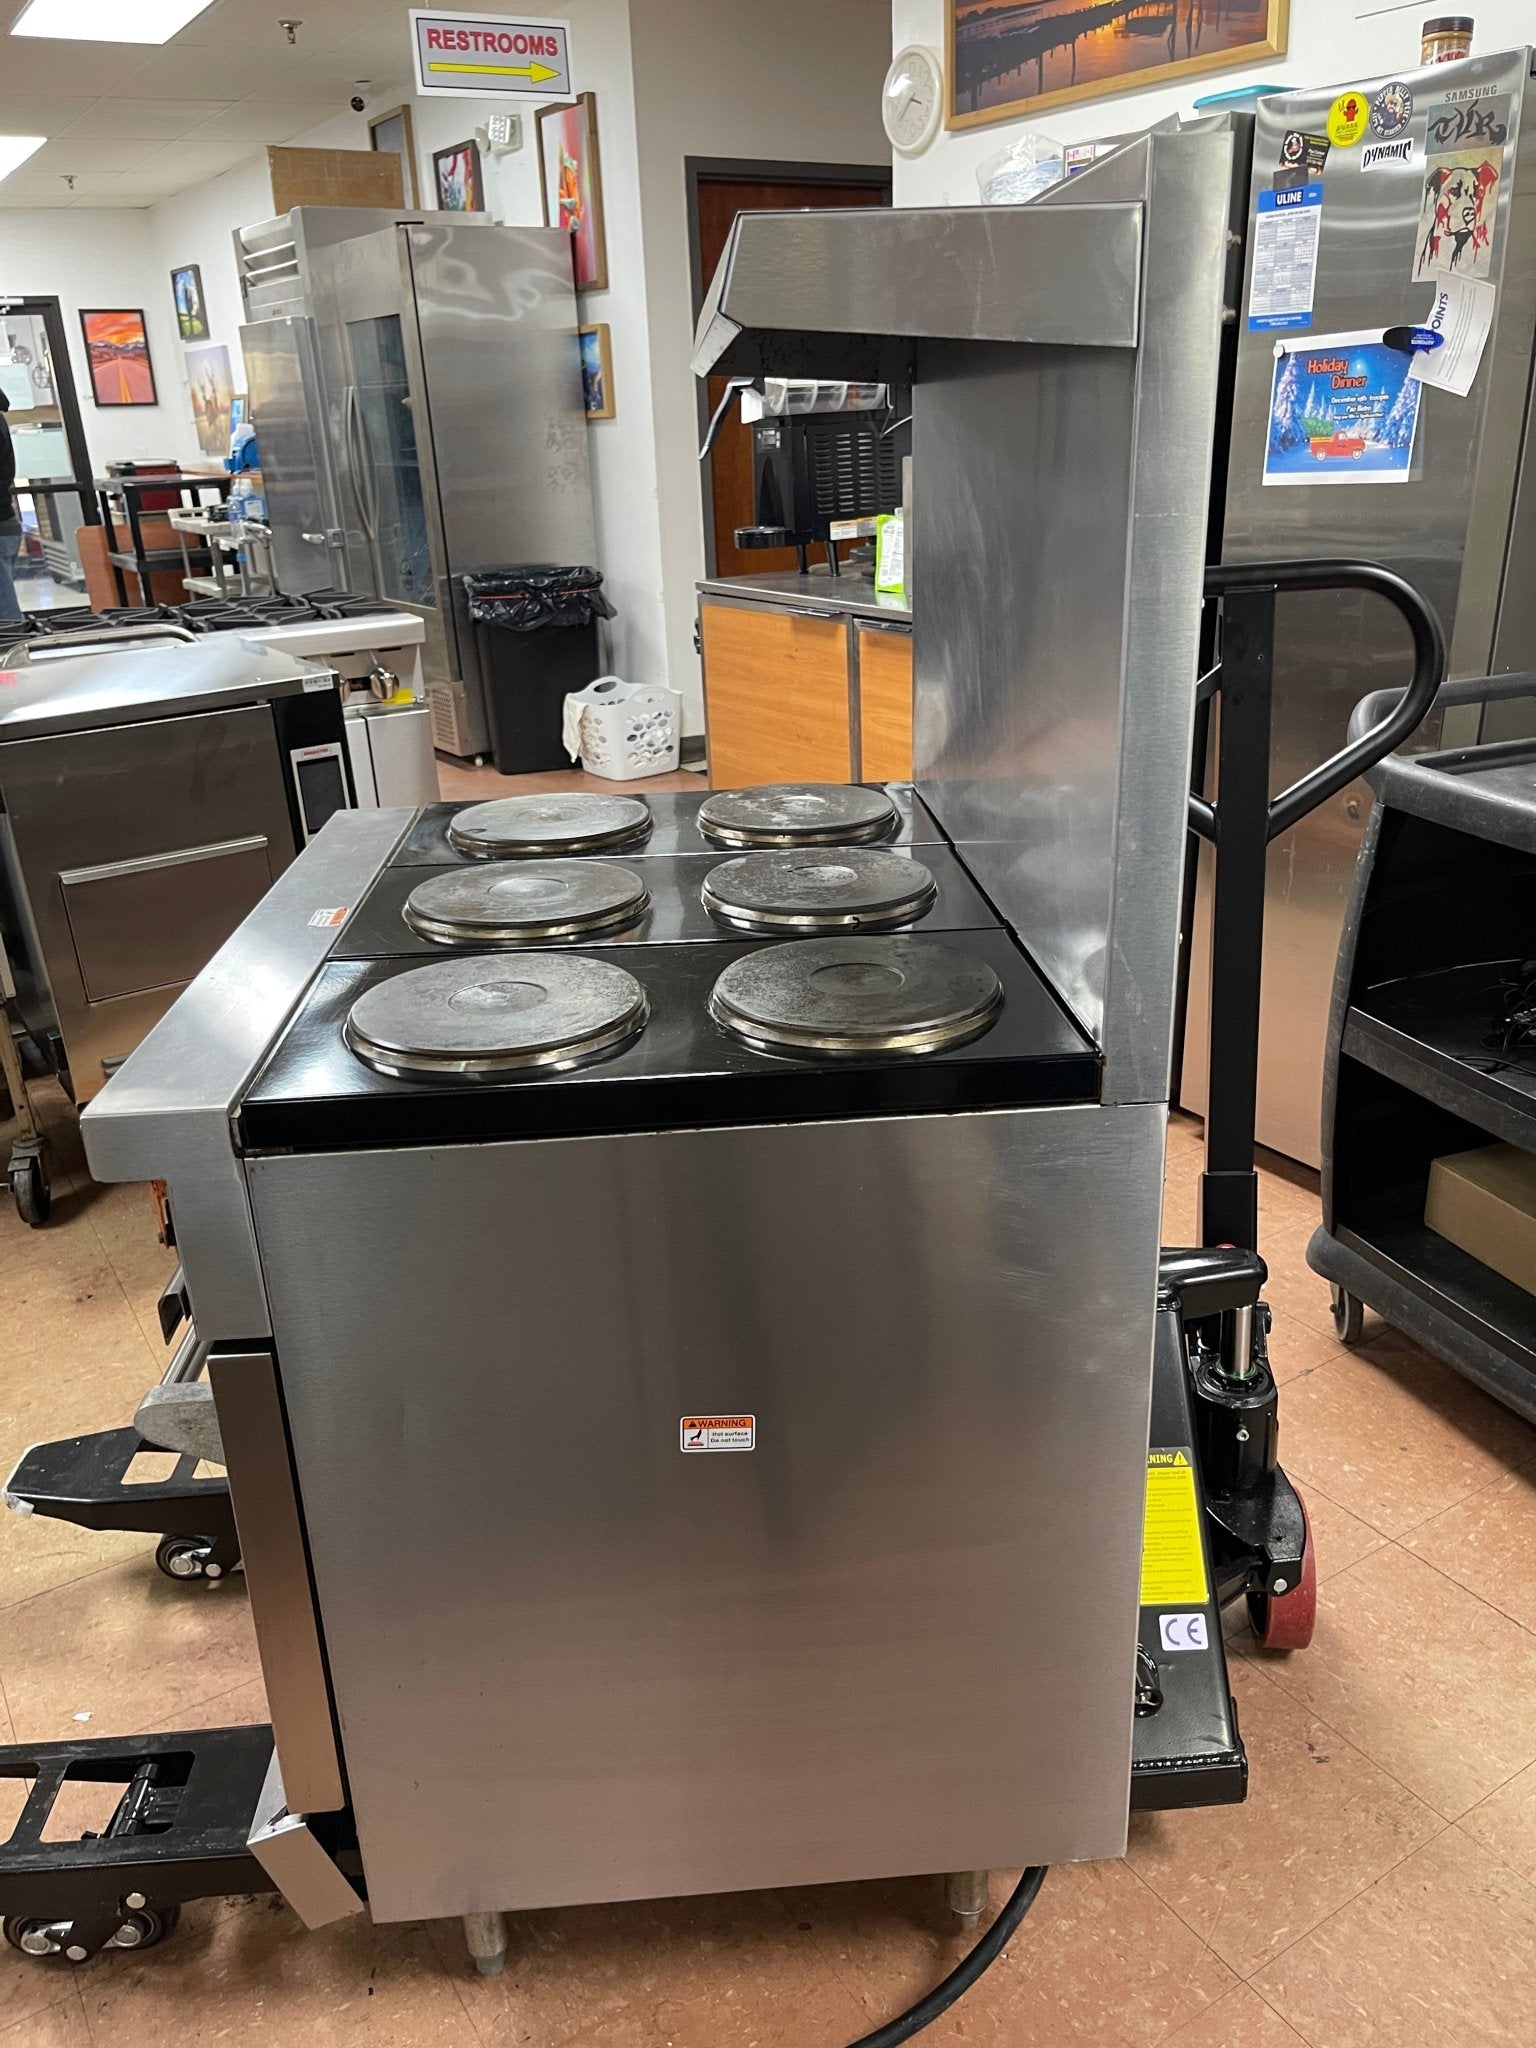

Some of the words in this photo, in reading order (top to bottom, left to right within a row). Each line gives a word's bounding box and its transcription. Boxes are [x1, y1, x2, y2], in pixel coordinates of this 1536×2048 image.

[426, 28, 559, 57] RESTROOMS
[1445, 85, 1497, 102] SAMSUNG
[1363, 140, 1412, 169] DYNAMIC
[1276, 191, 1303, 205] ULINE
[1307, 357, 1349, 375] Holiday
[1331, 375, 1367, 390] Dinner
[698, 1419, 746, 1427] WARNING
[1148, 1453, 1173, 1464] NING
[1165, 1617, 1202, 1646] CE
